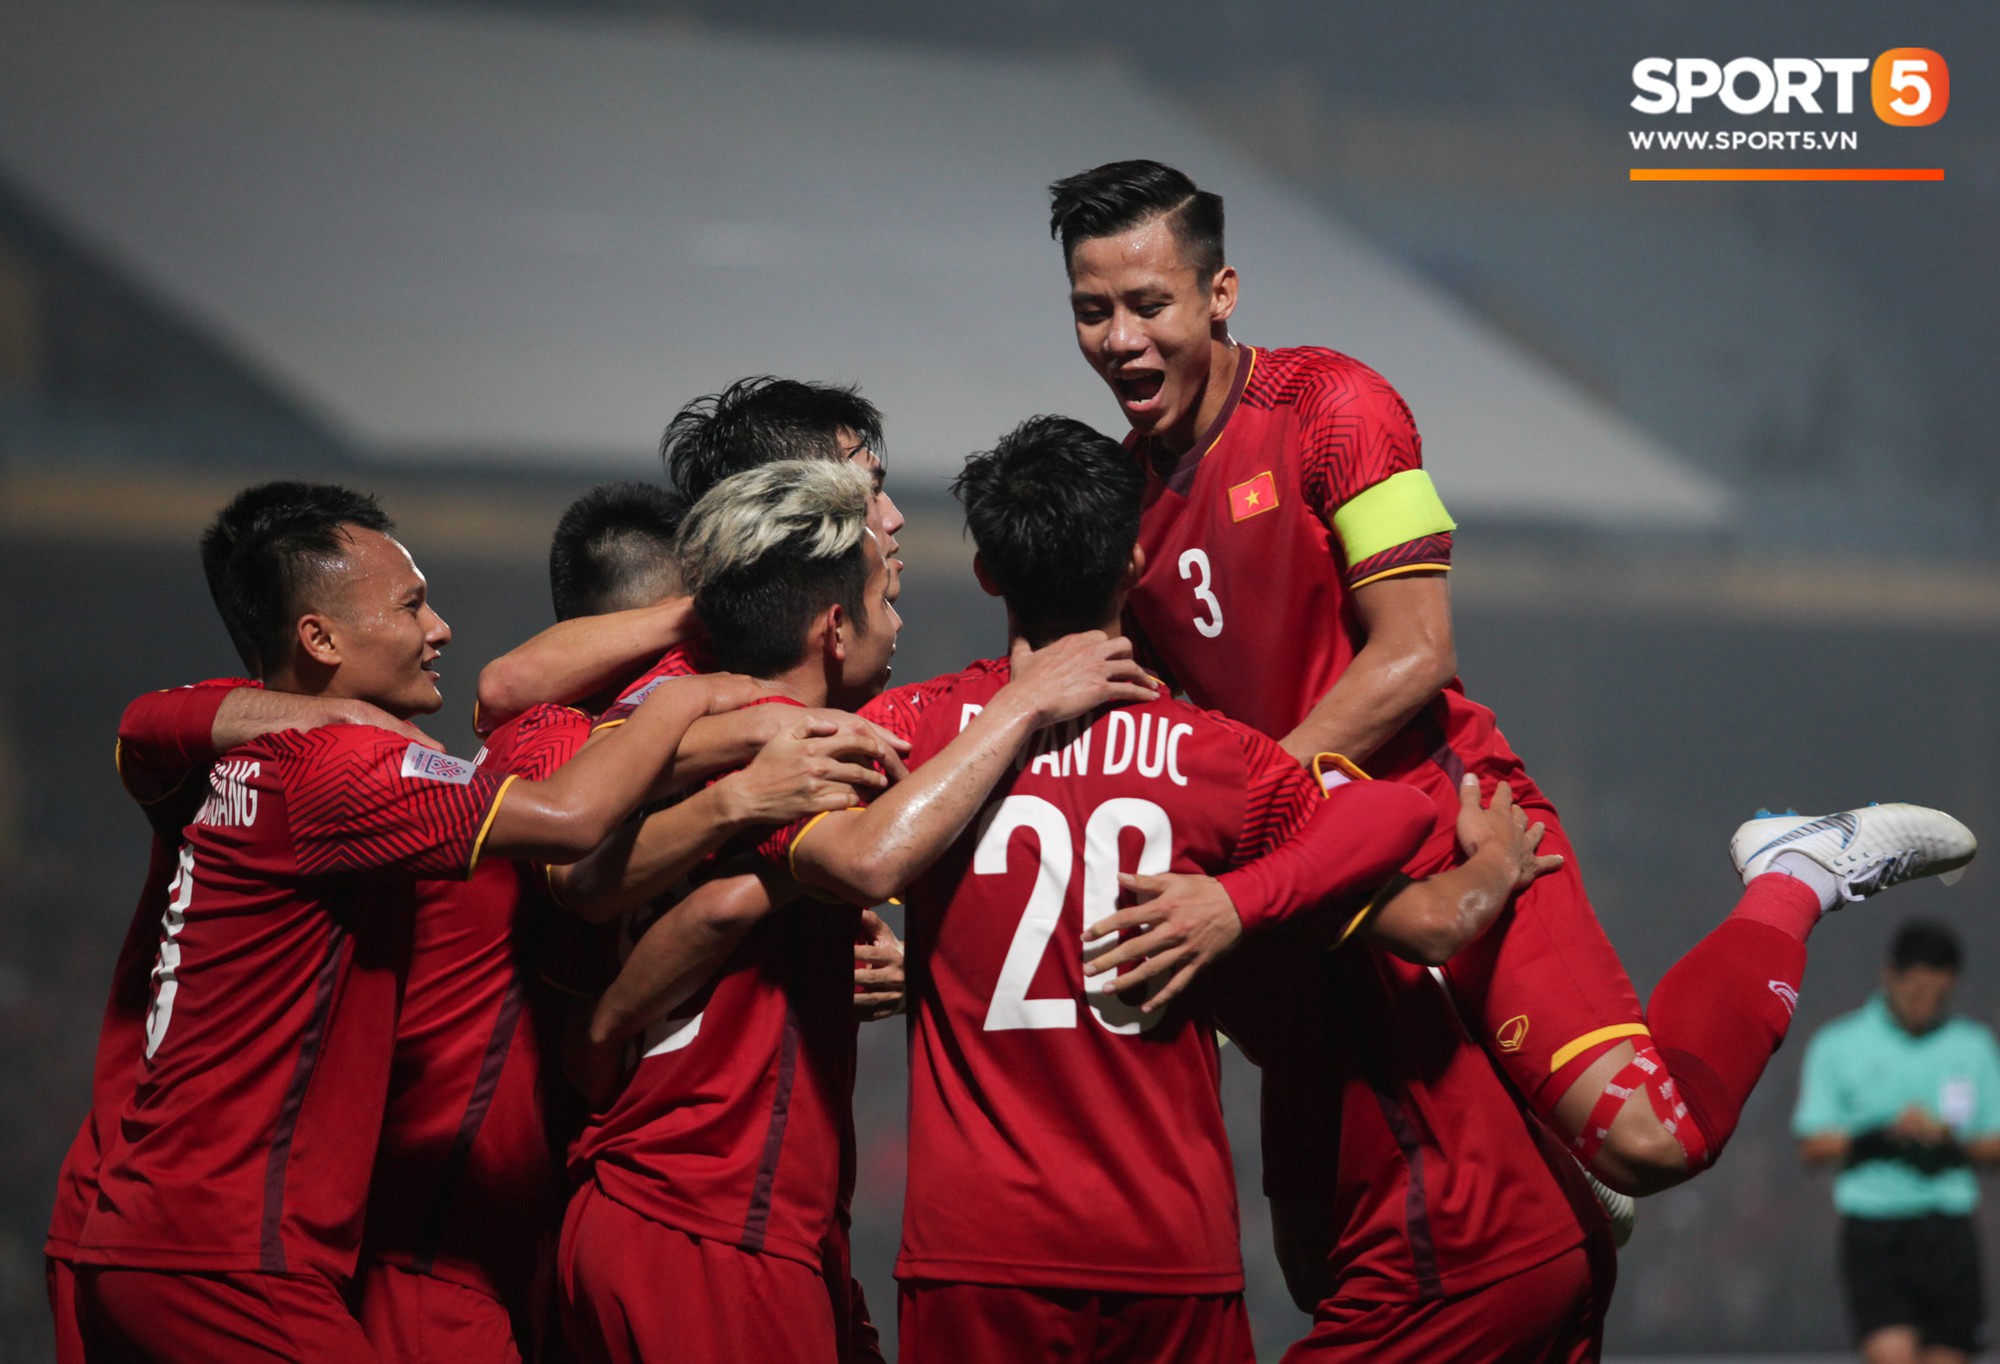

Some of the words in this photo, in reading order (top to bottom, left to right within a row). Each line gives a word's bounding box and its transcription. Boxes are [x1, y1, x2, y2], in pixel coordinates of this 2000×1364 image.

[1178, 548, 1223, 638] 3
[1103, 710, 1194, 786] DUC
[973, 794, 1173, 1035] 20
